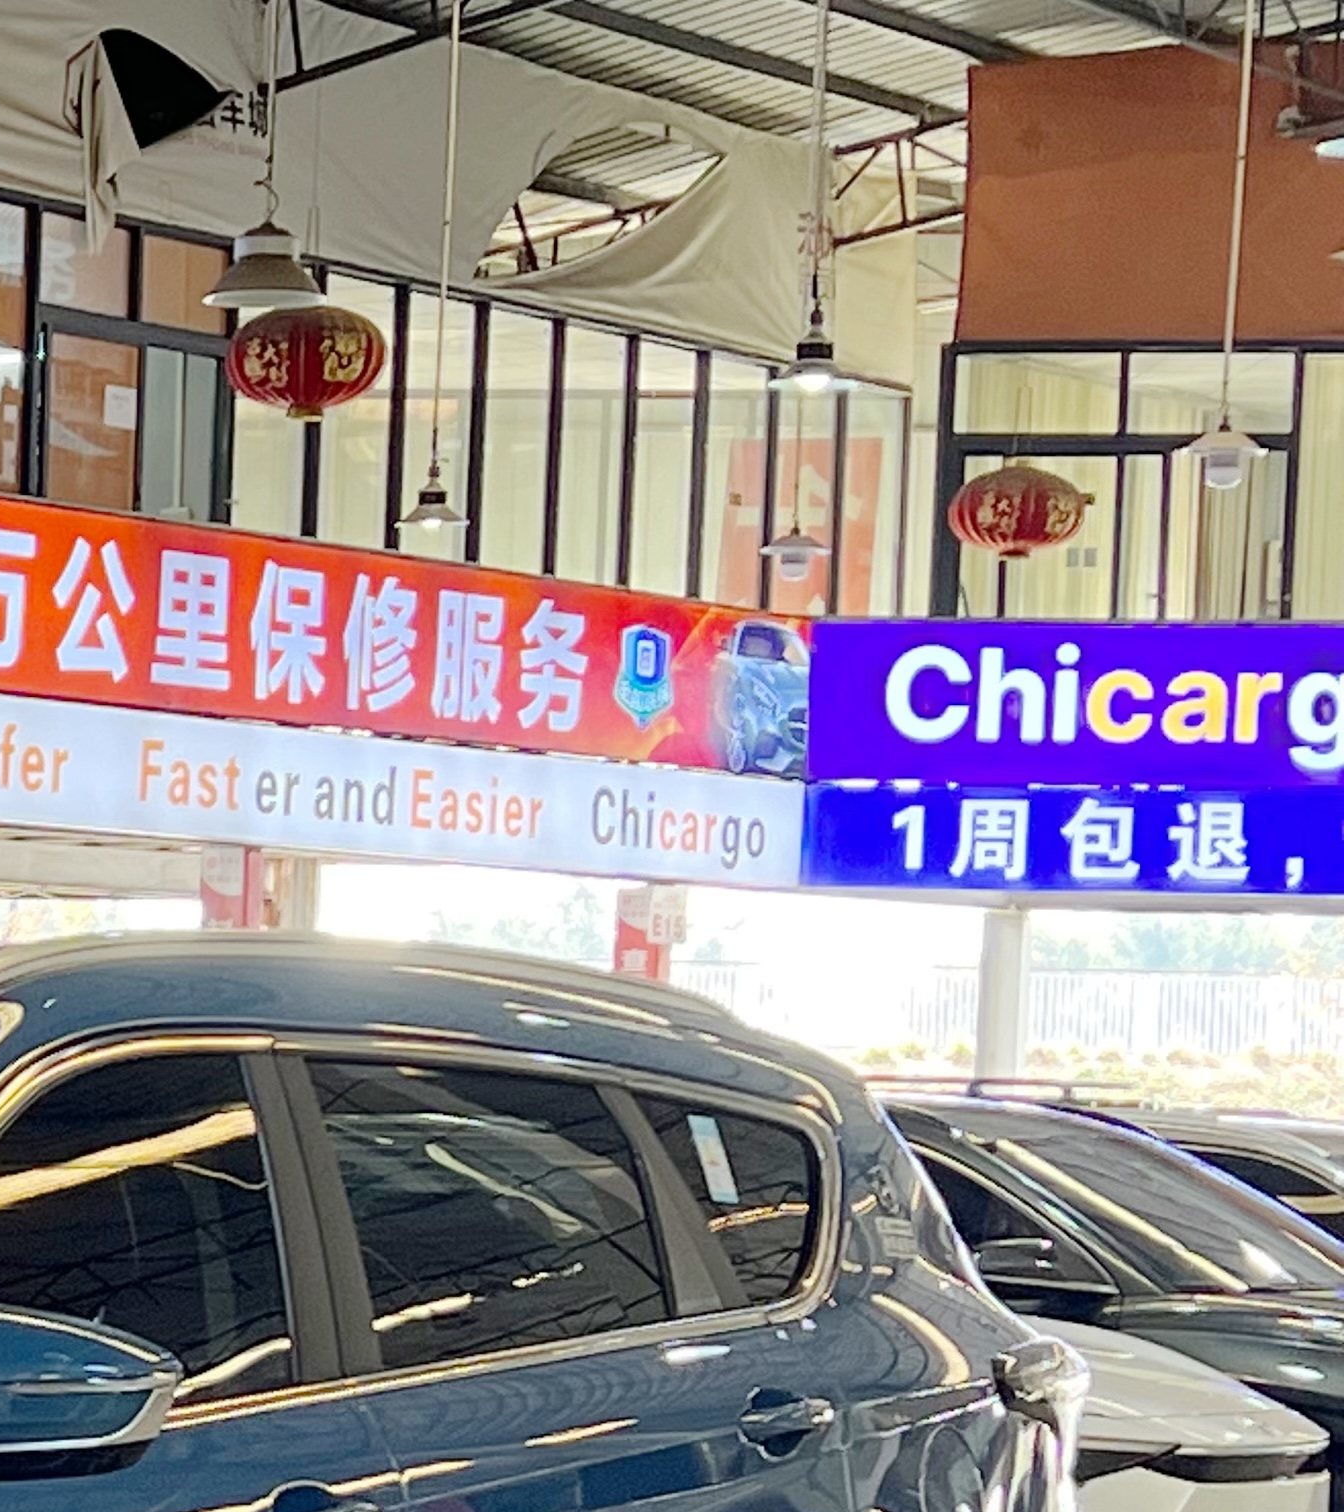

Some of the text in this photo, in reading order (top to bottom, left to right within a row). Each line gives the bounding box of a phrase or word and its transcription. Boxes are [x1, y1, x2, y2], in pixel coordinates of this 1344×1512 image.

[138, 738, 241, 812] Fast
[314, 766, 395, 828] and
[409, 769, 544, 839] Easier
[590, 785, 767, 870] Chicargo
